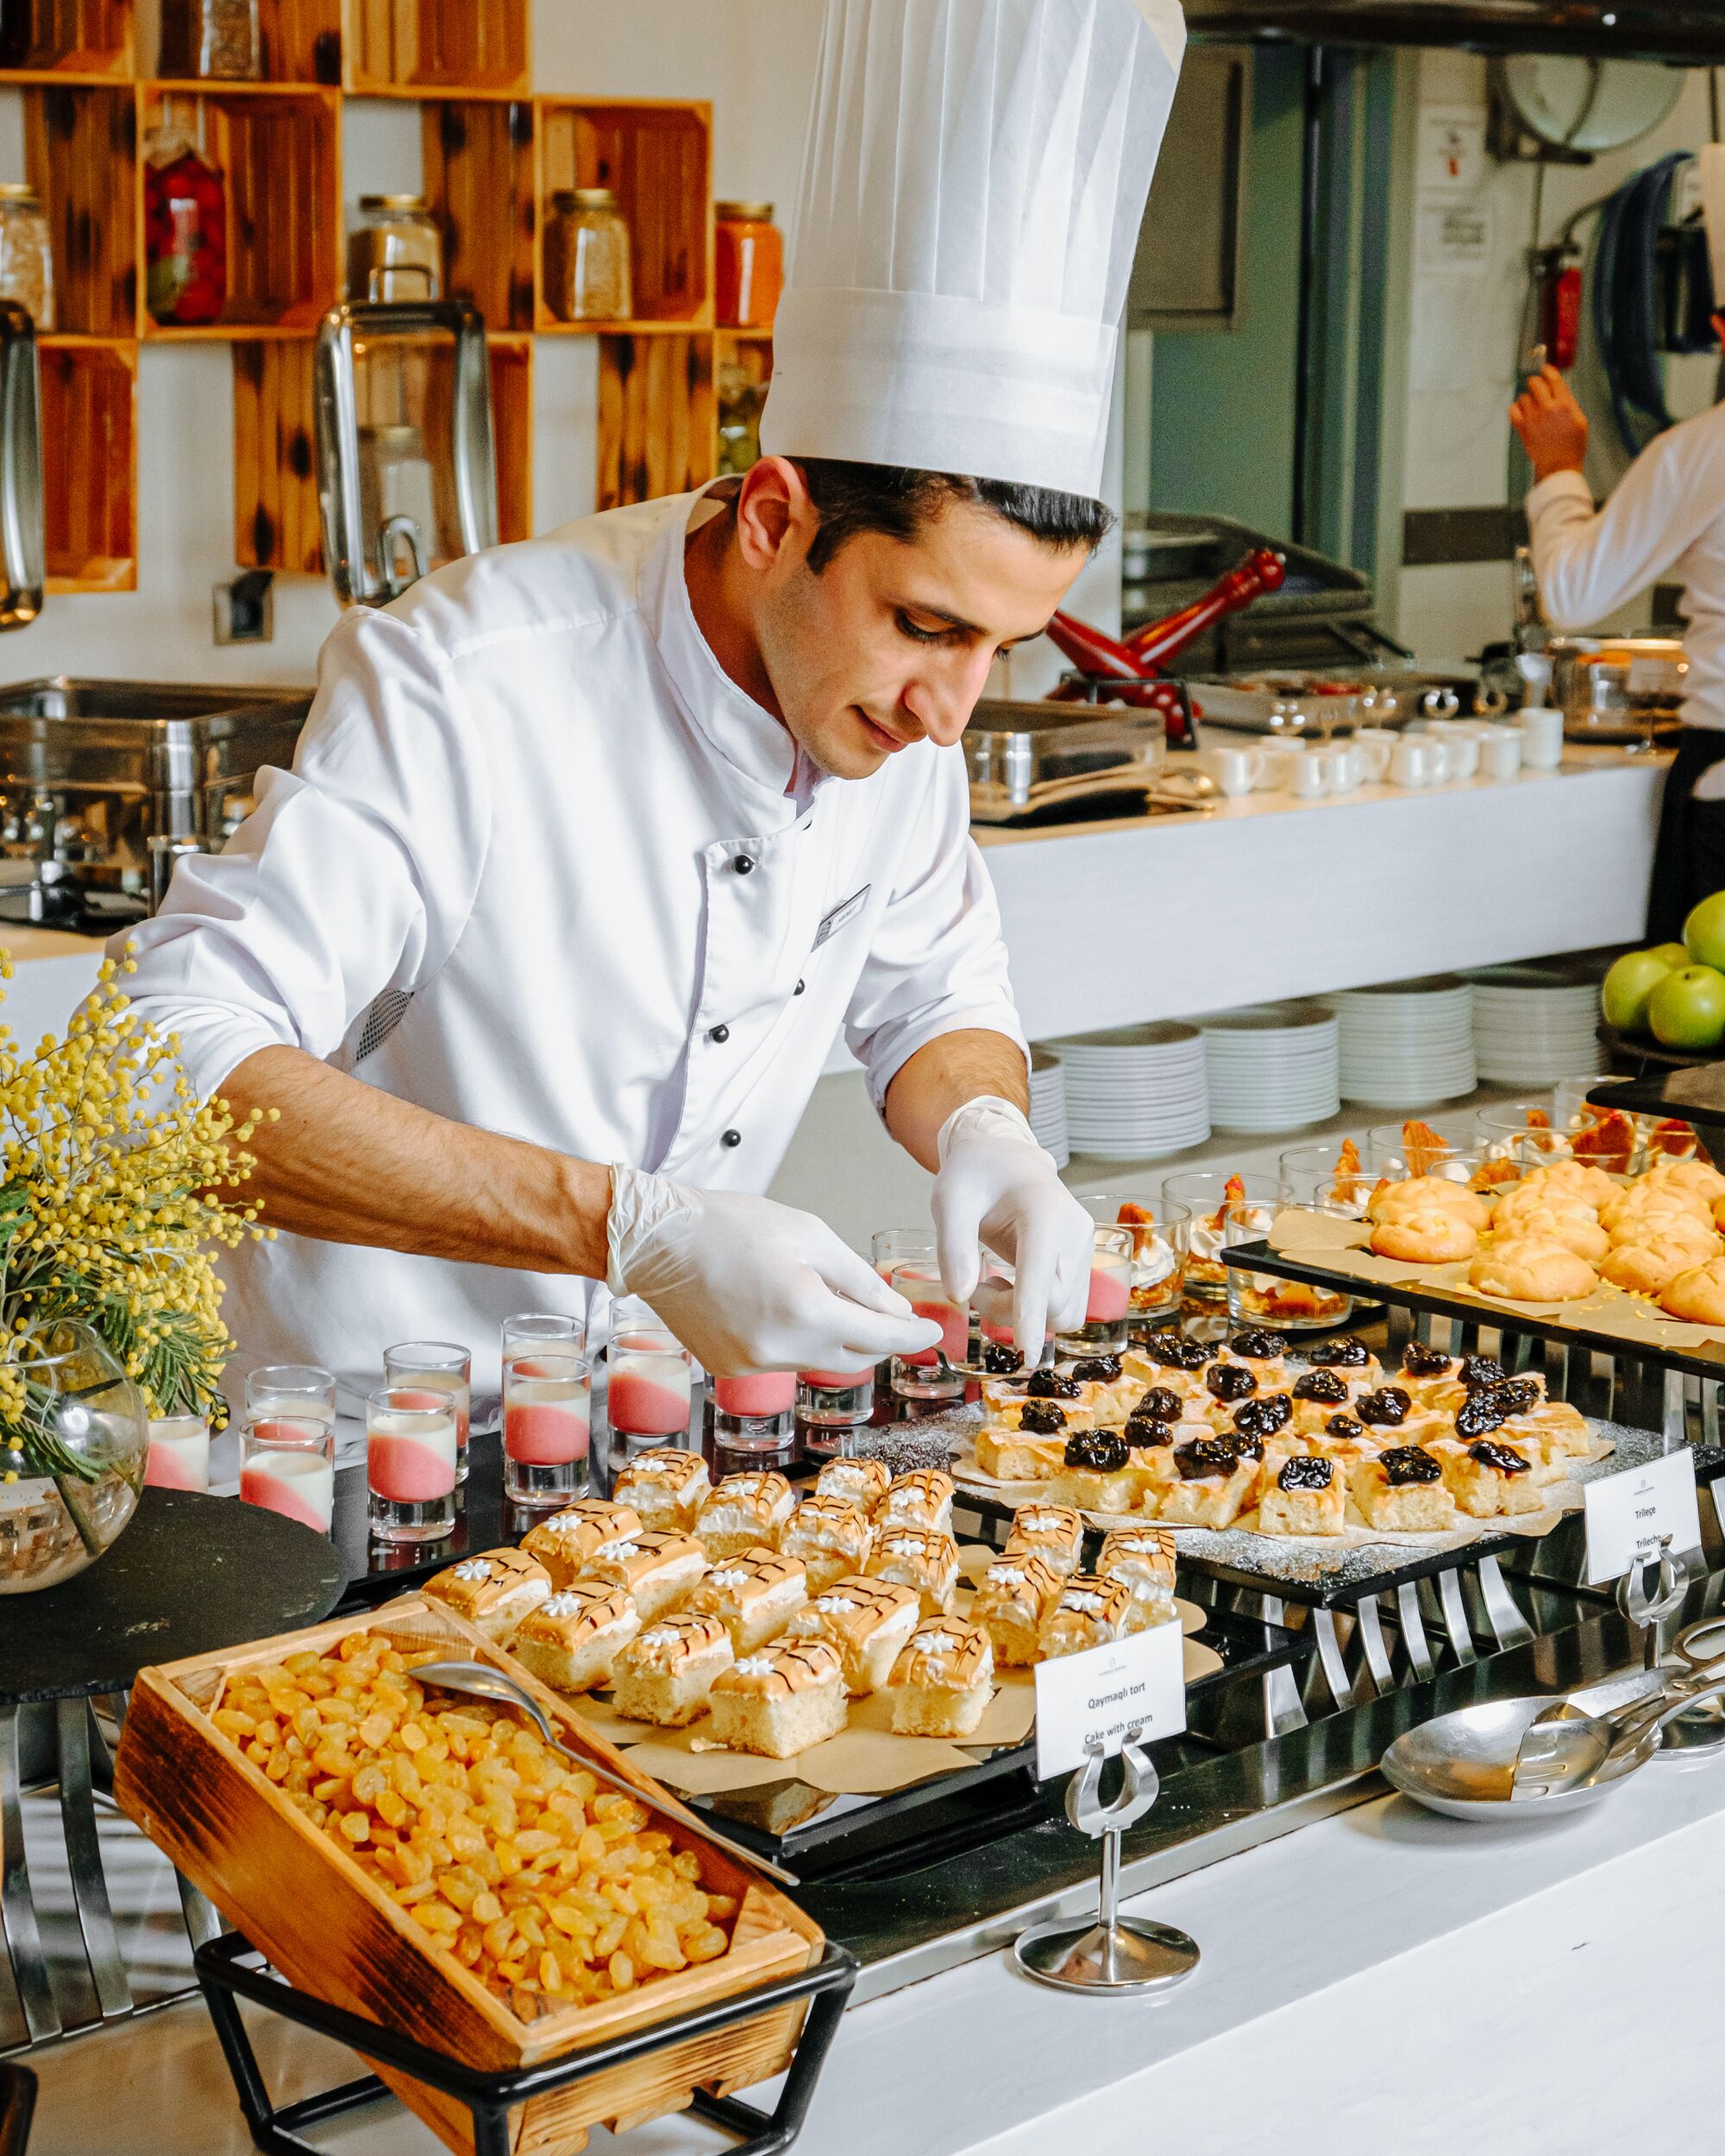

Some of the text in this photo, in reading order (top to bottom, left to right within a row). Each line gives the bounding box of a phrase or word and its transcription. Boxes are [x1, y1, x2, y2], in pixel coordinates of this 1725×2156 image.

[1634, 1507, 1656, 1520] Trileçe
[1088, 1683, 1145, 1709] Qaymaqlı tort
[1084, 1714, 1153, 1745] Cake with cream
